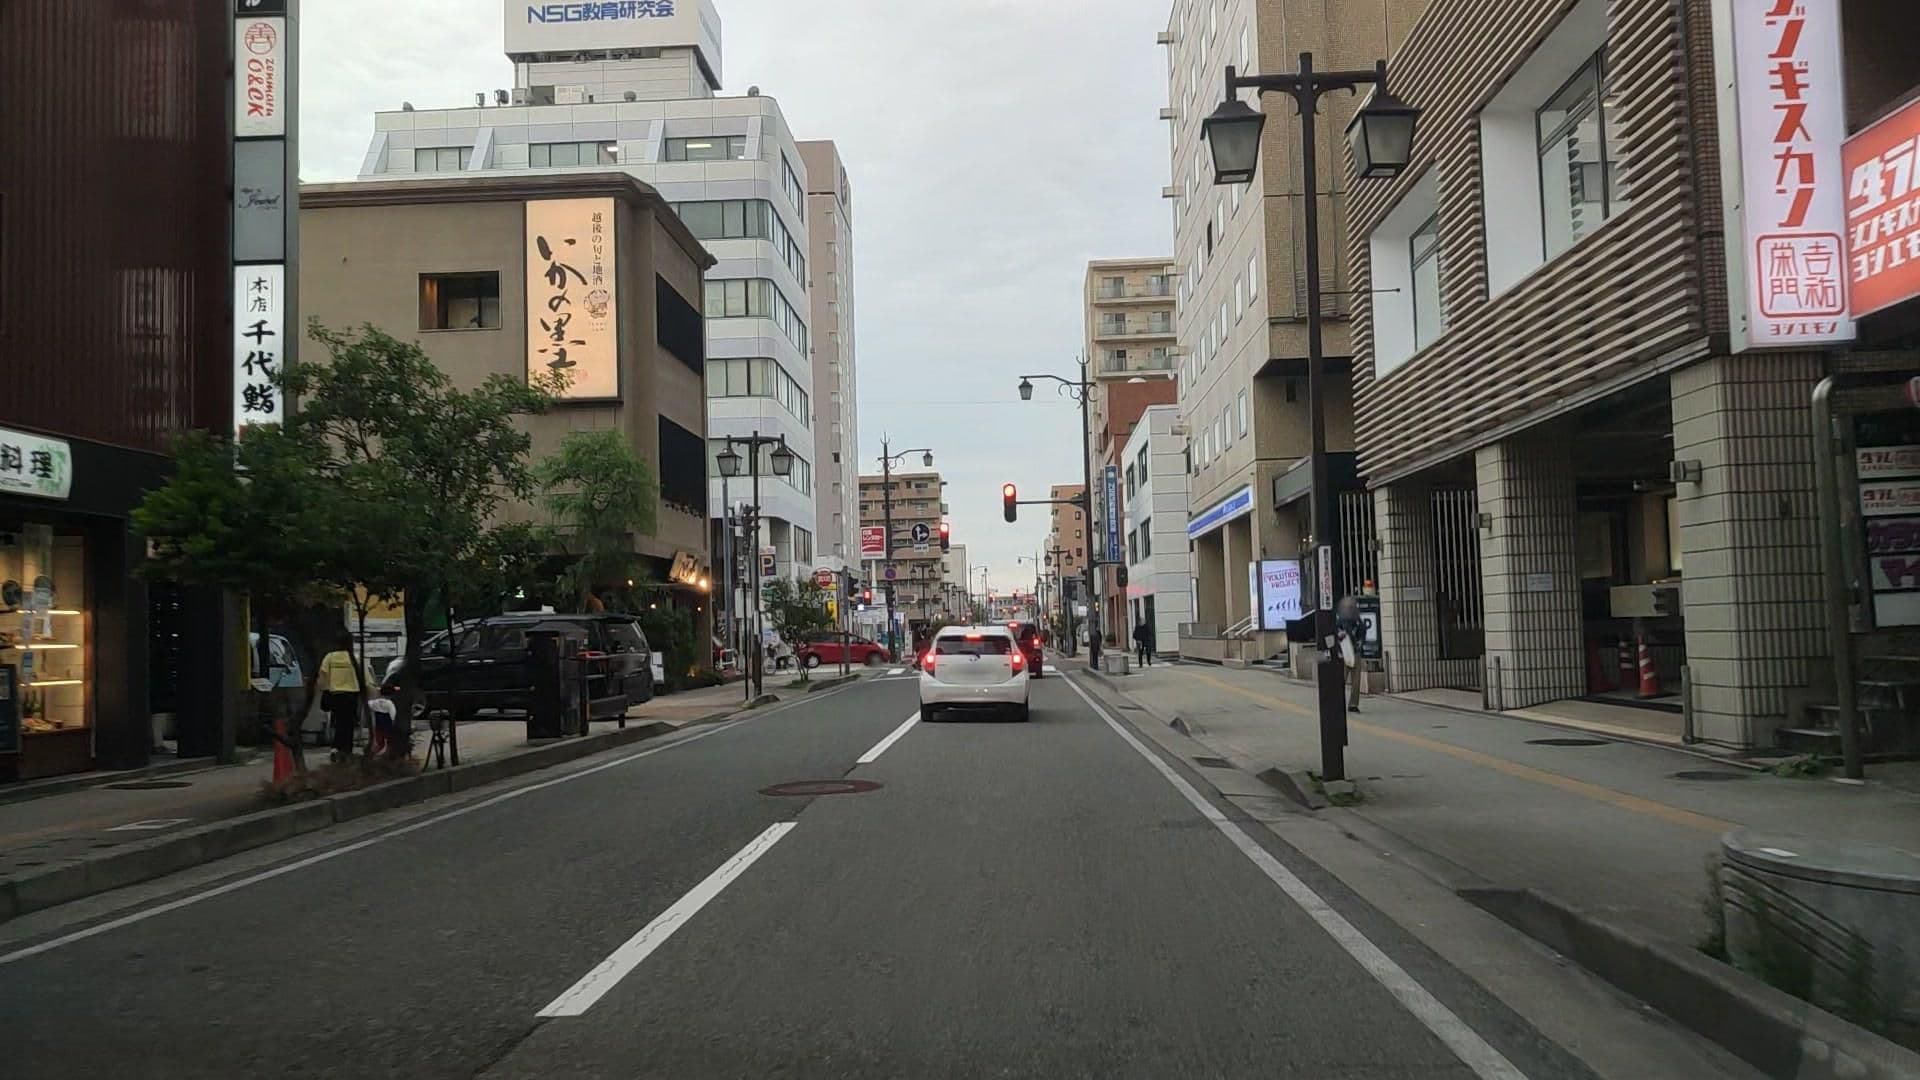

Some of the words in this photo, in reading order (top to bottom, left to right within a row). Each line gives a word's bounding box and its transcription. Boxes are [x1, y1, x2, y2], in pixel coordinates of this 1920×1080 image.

[528, 1, 675, 23] NSG教育研究会
[249, 276, 268, 312] 本店
[1769, 322, 1837, 336] ヨシエモン
[761, 555, 774, 576] P
